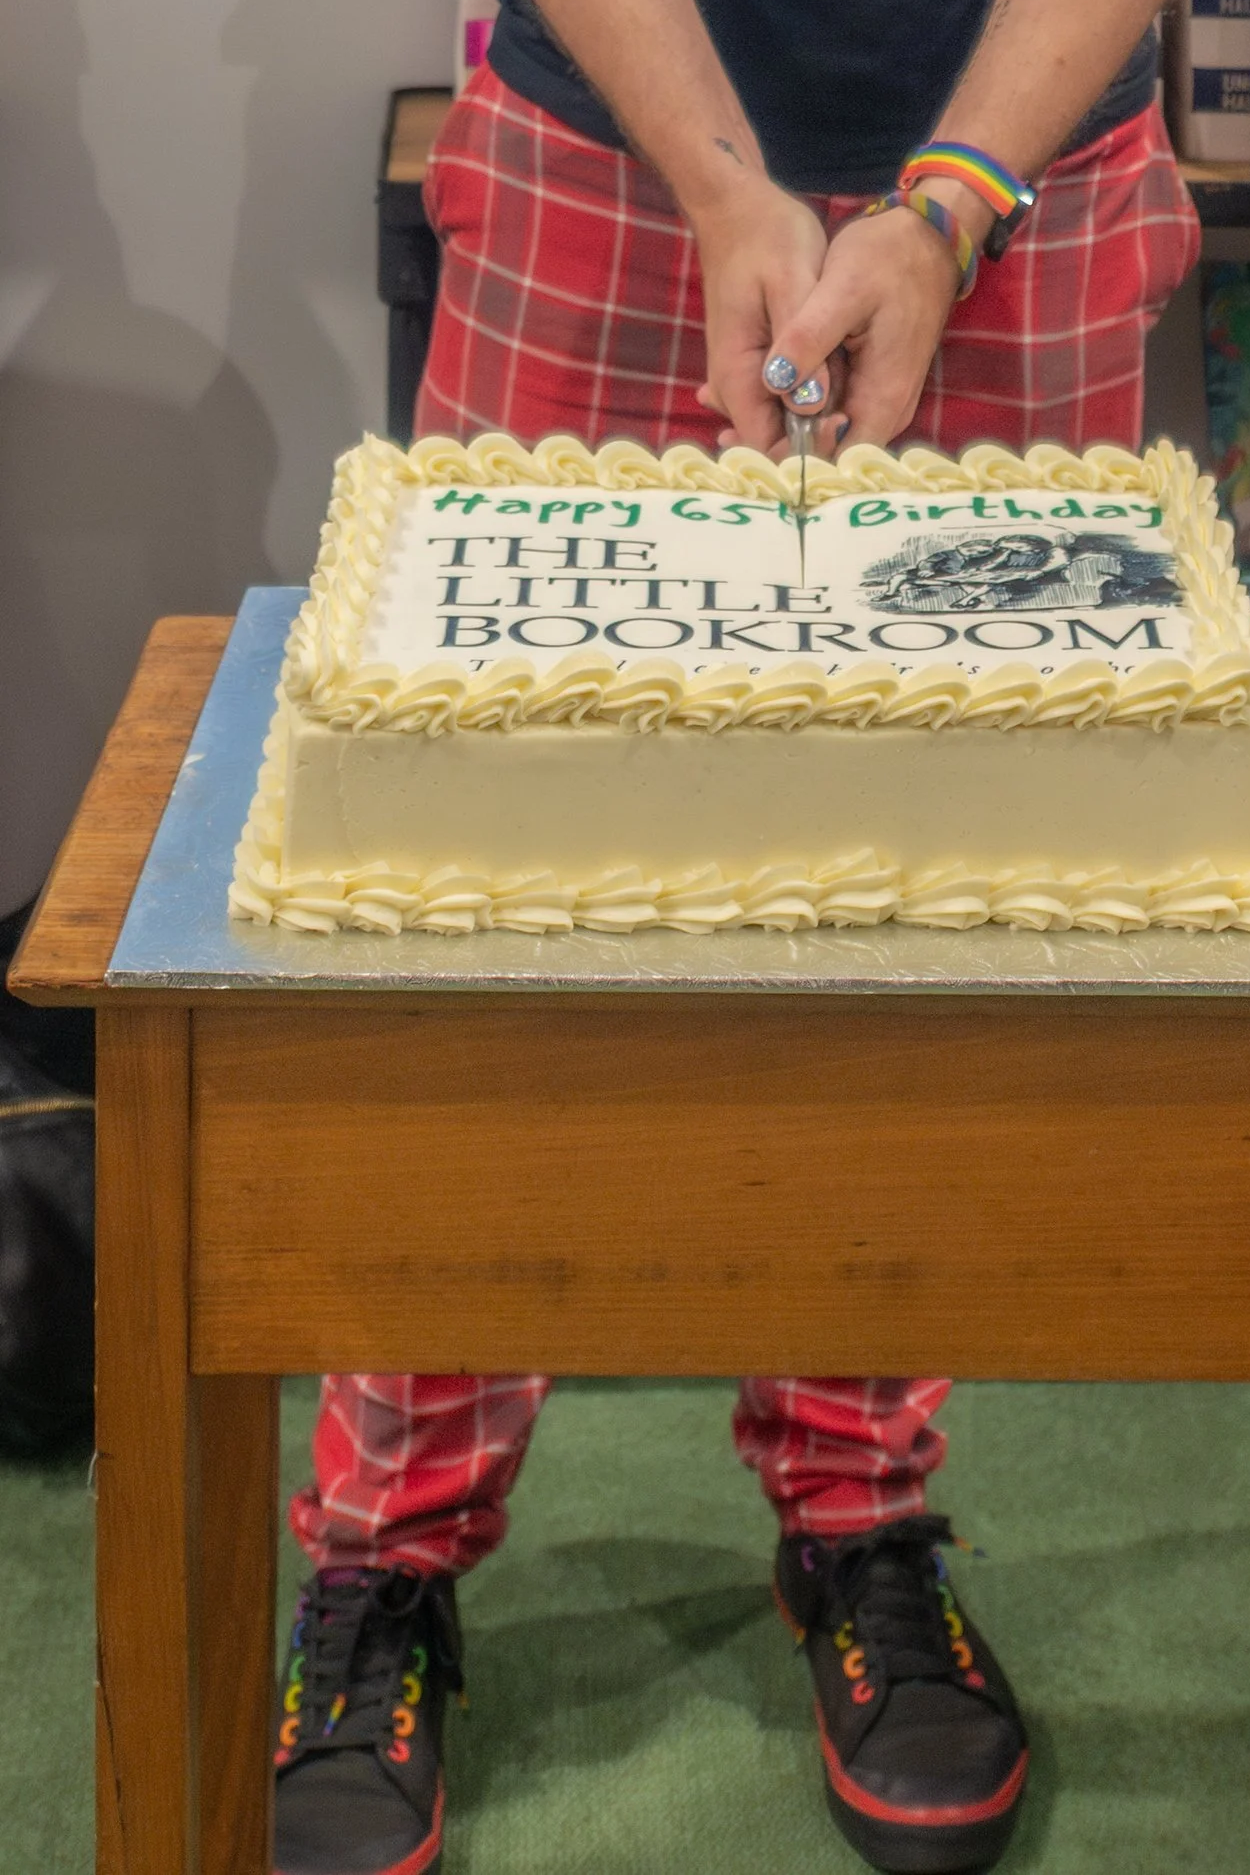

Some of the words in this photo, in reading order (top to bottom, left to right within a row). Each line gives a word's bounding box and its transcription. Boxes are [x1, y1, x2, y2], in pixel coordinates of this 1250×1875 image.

[434, 490, 641, 528] Happy
[850, 496, 1166, 528] Birthday
[428, 536, 659, 572] THE
[436, 575, 833, 613] LITTLE
[435, 614, 1175, 653] BOOKROOM
